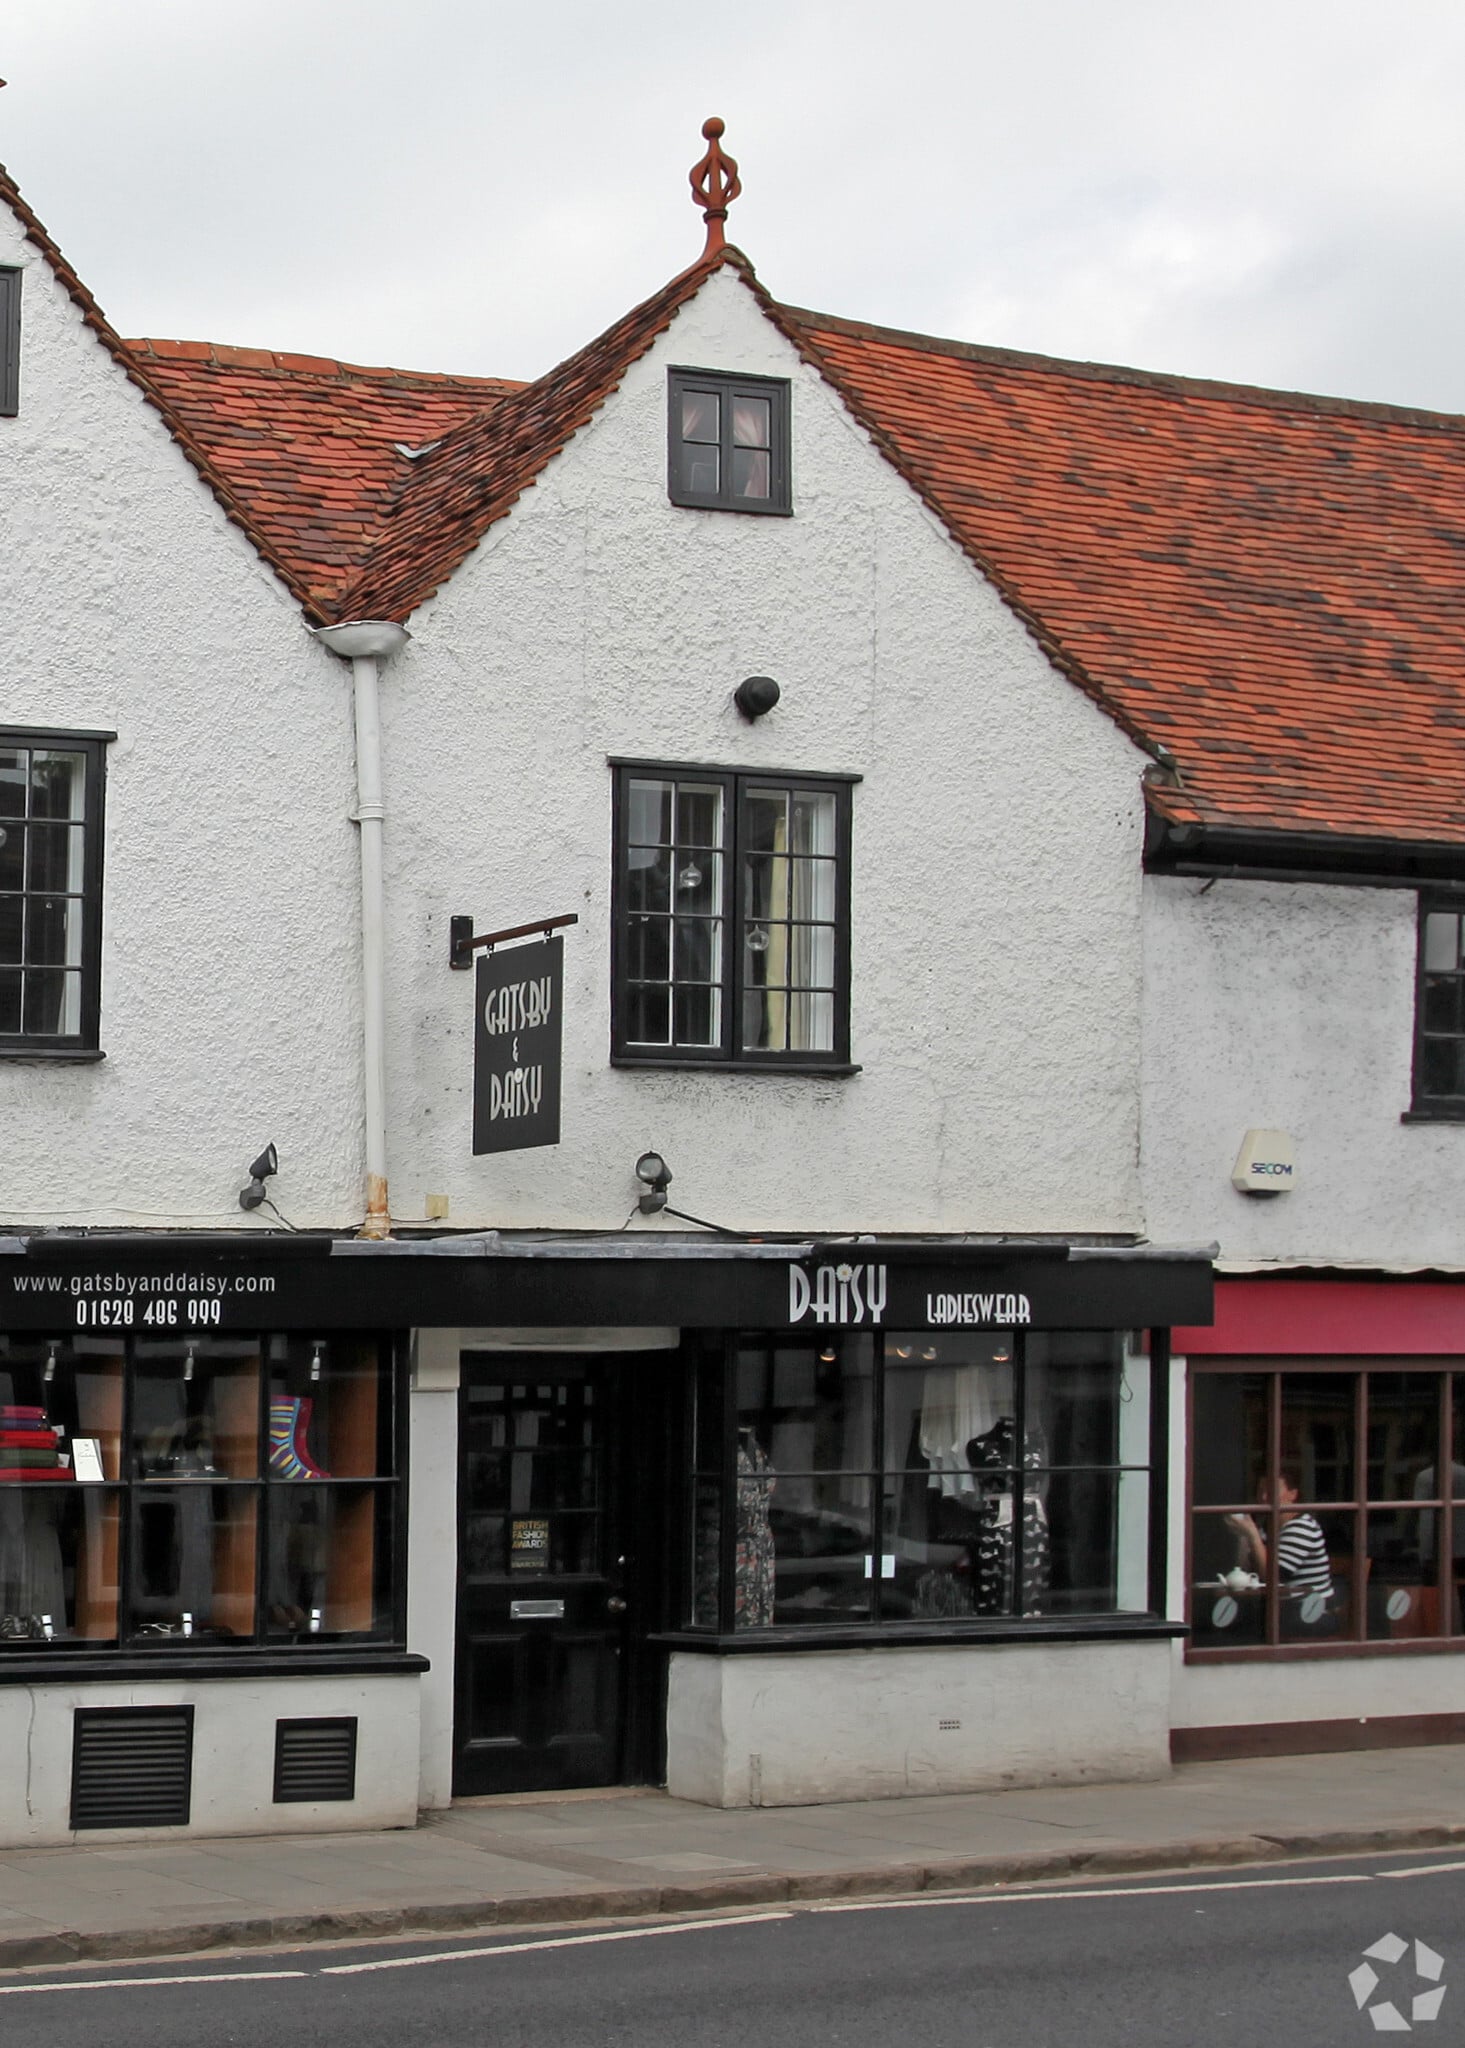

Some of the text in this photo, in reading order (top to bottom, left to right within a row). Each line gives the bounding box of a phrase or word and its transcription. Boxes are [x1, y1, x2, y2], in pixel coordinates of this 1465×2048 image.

[485, 976, 551, 1035] GATSBY
[512, 1036, 519, 1062] &
[490, 1065, 542, 1120] DAISY
[1251, 1162, 1293, 1176] SECOM
[13, 1272, 276, 1296] www.gatsbyanddaisy.com
[789, 1263, 1031, 1324] DAISY LADIESWEAR
[76, 1299, 221, 1326] 01628 486 999
[512, 1521, 549, 1530] BRITISH
[512, 1530, 548, 1540] FASHION
